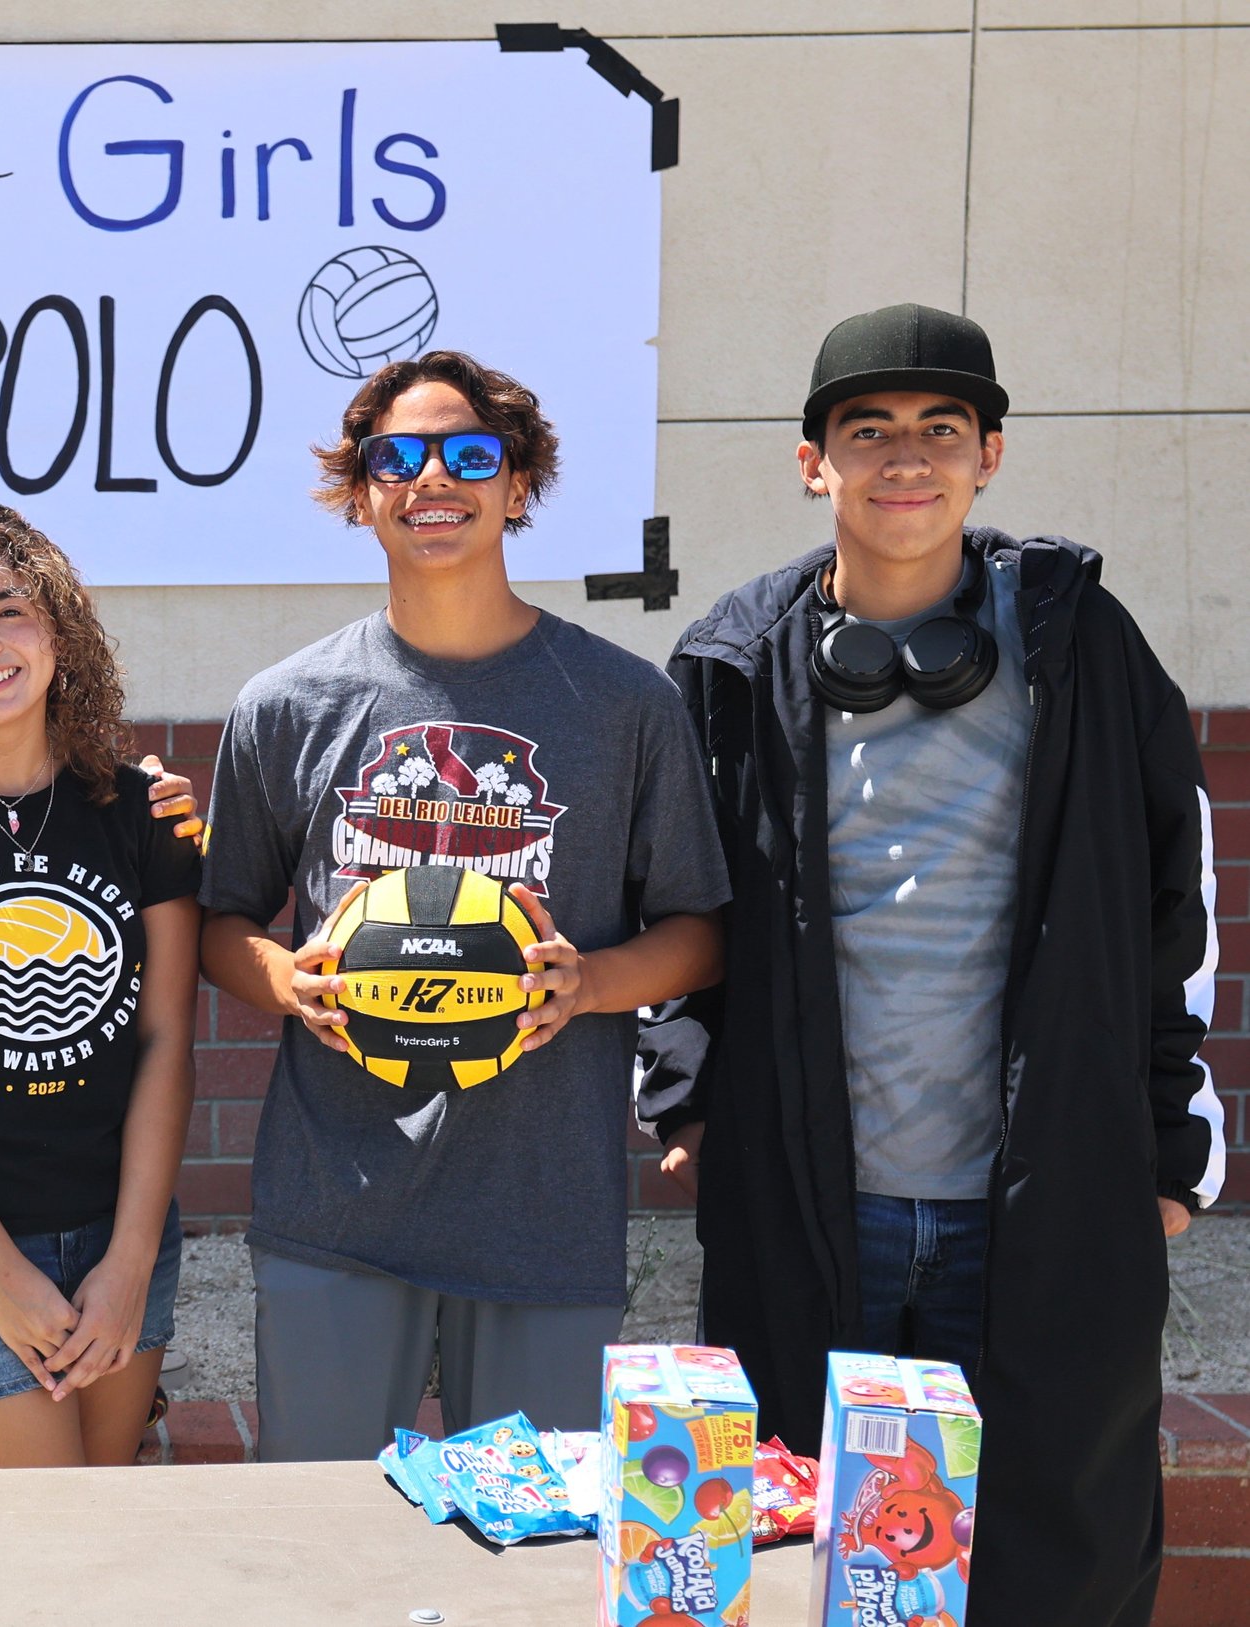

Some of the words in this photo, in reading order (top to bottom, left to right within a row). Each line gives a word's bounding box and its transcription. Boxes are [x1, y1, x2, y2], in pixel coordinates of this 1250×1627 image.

[58, 74, 447, 231] Girls
[377, 796, 412, 820] DEL
[416, 799, 449, 823] RIO
[452, 801, 522, 829] LEAGUE
[13, 852, 48, 873] FE
[67, 863, 135, 921] HIGH
[400, 938, 457, 956] NCAA
[355, 982, 398, 1001] KAP
[456, 987, 503, 1004] SEVEN
[3, 1039, 94, 1072] WATER
[100, 978, 141, 1042] POLO
[395, 1035, 450, 1047] HydroGrip
[453, 1037, 460, 1046] 5
[28, 1080, 66, 1095] 2022
[723, 1415, 731, 1433] LESS
[725, 1435, 733, 1461] SUGAR
[645, 1569, 659, 1594] PUNCH
[650, 1561, 667, 1595] TROPICAL
[655, 1546, 689, 1611] Jammers
[675, 1532, 716, 1610] Kool-Aid
[901, 1585, 913, 1617] TROPICAL
[909, 1587, 919, 1610] PUNCH
